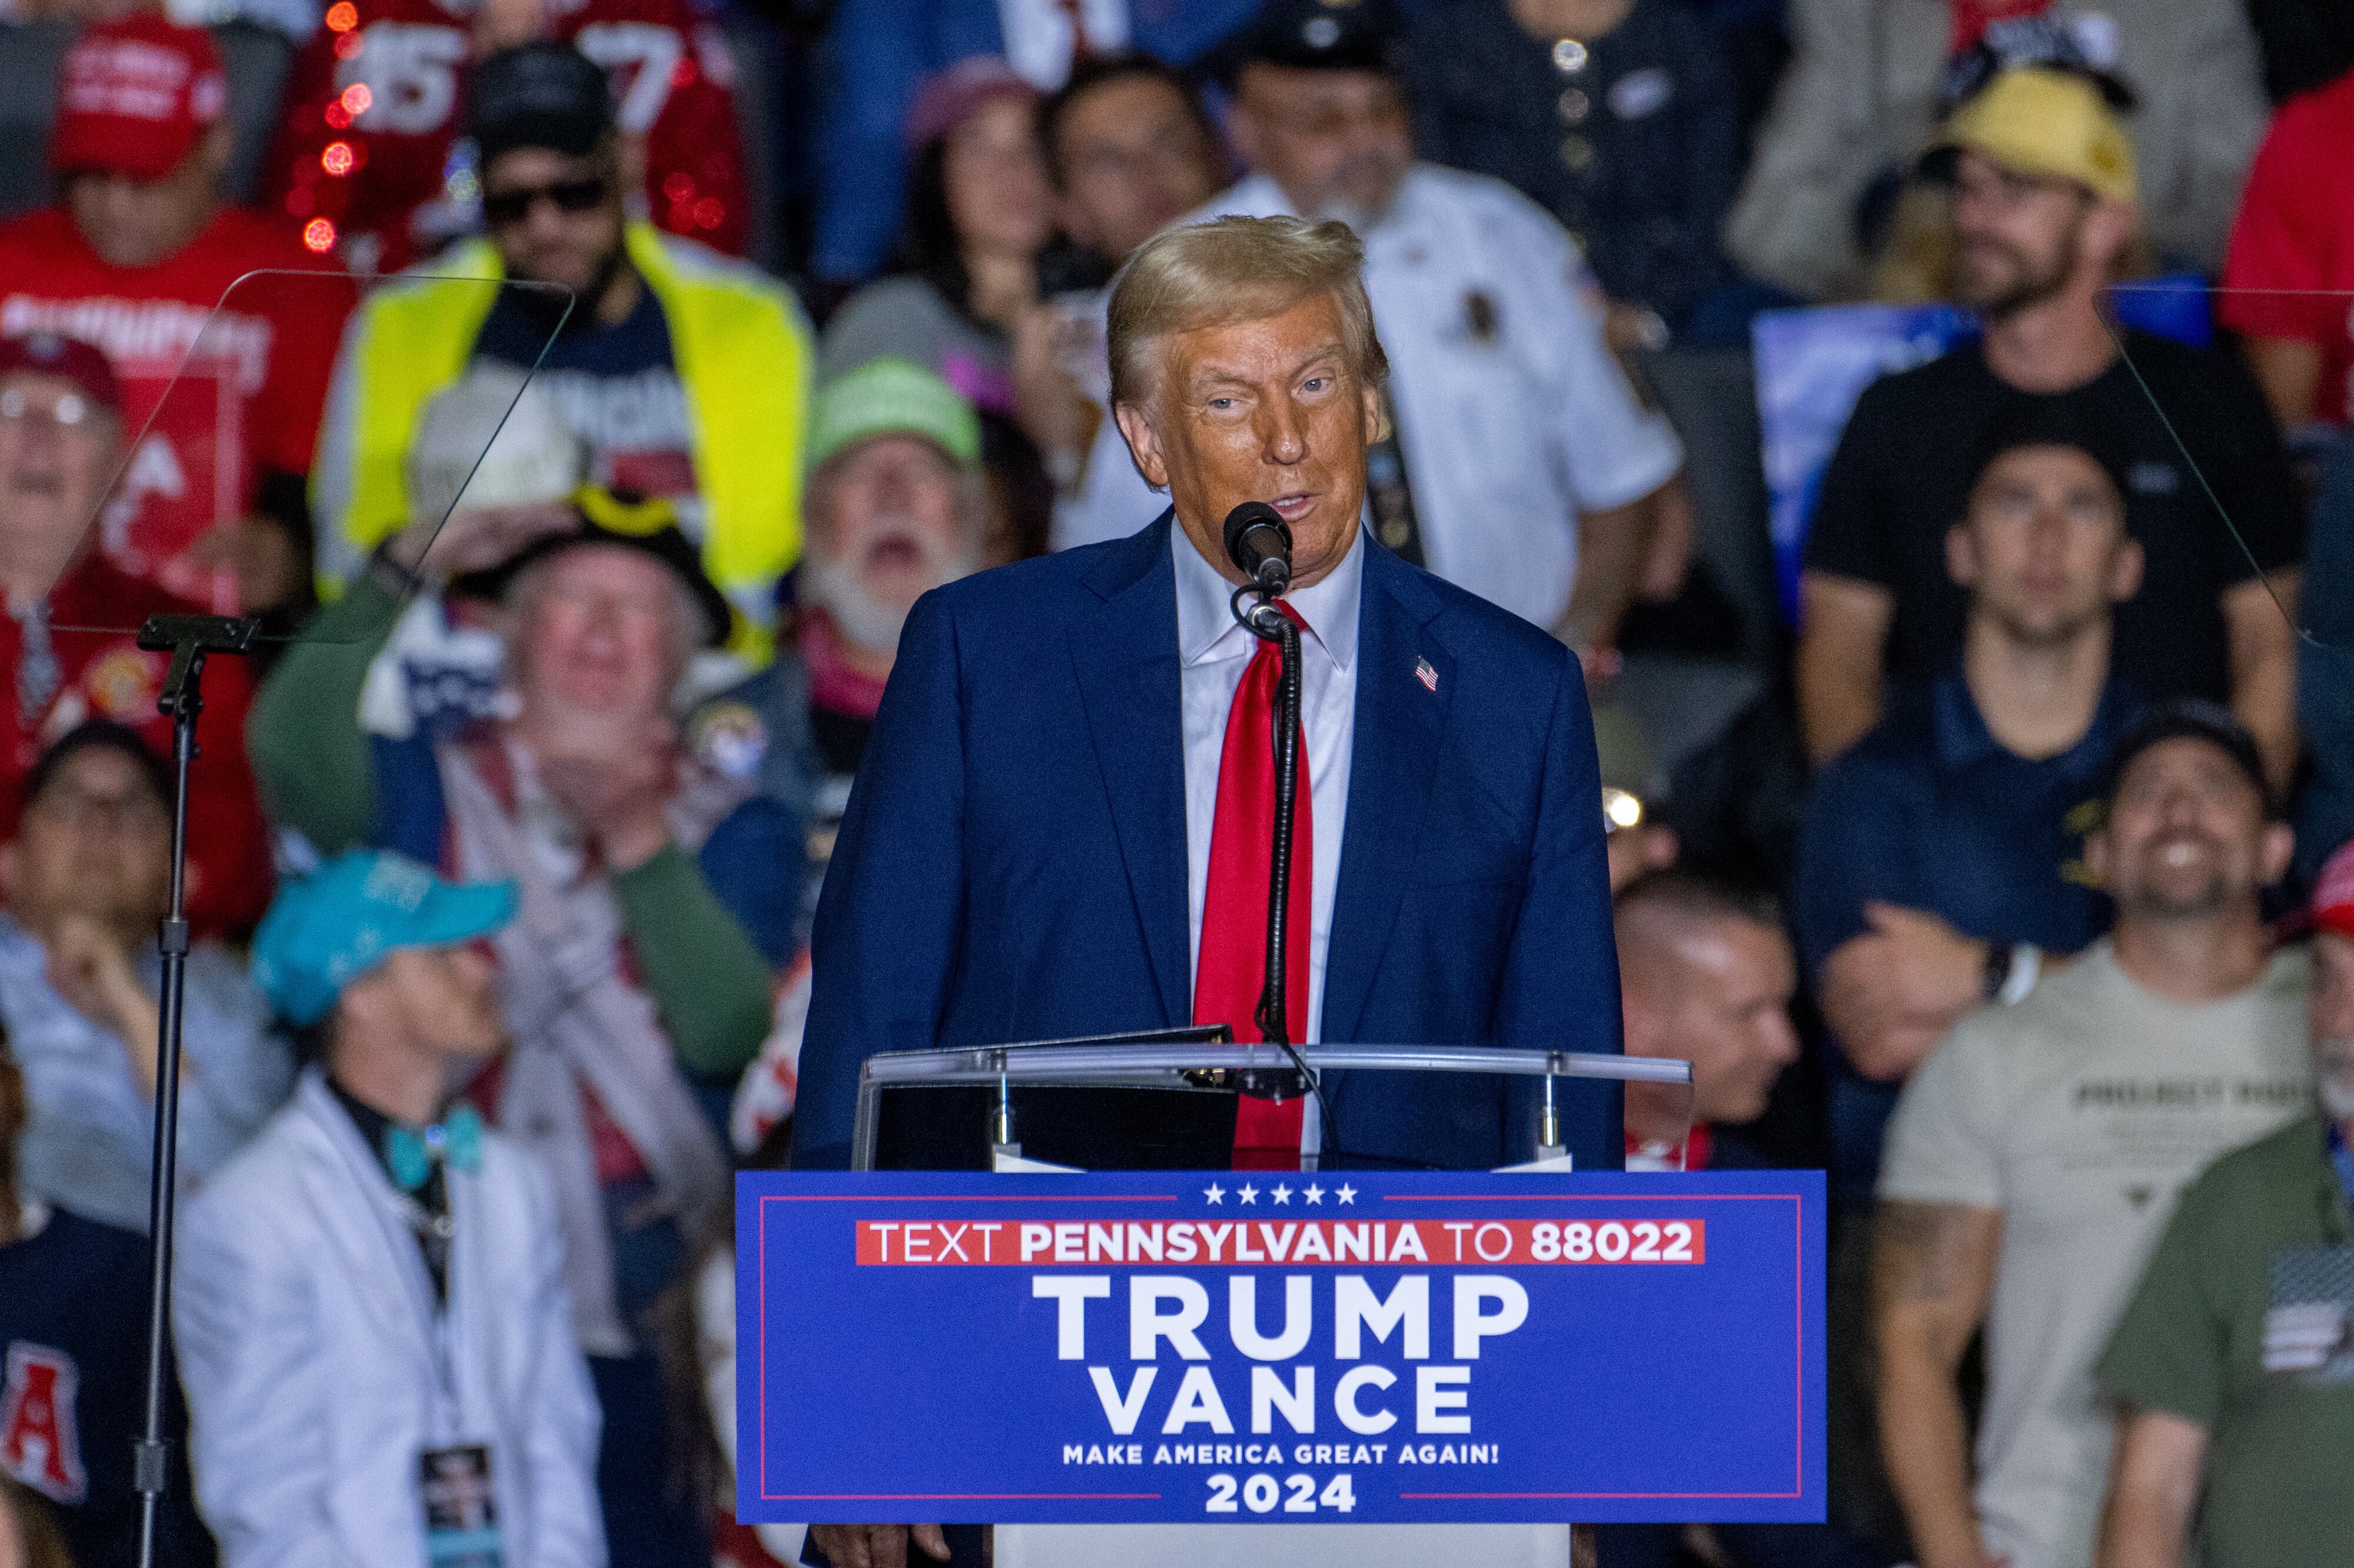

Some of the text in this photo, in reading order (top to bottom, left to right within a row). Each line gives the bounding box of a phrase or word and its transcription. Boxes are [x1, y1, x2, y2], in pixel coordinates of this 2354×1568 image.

[870, 1222, 1694, 1263] TEXT PENNSYLVANIA TO 88022
[1032, 1274, 1530, 1363] TRUMP
[2, 1346, 82, 1499] A
[1088, 1364, 1472, 1436] VANCE
[1063, 1444, 1499, 1466] MAKE AMERICA GREAT AGAIN!
[1206, 1473, 1358, 1514] 2024
